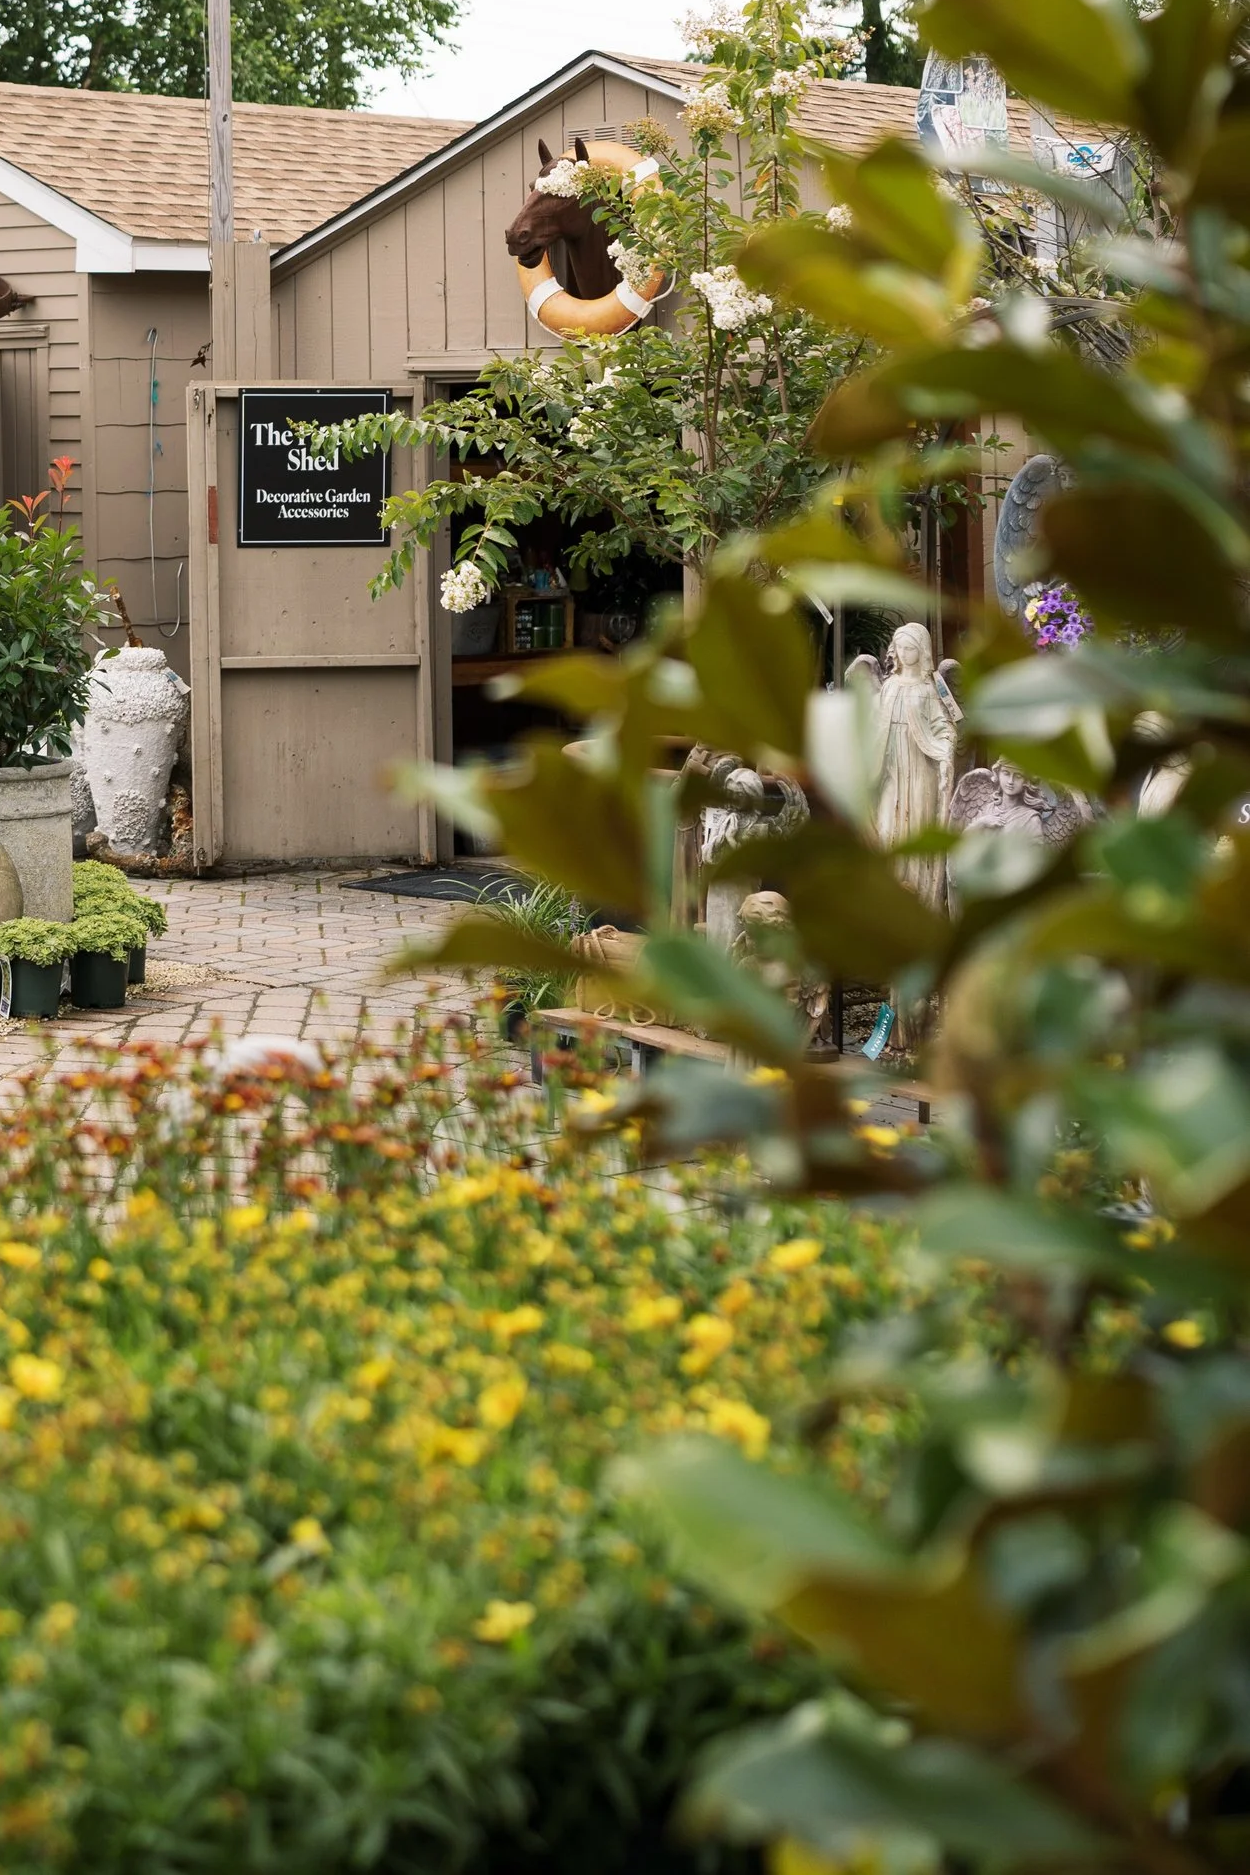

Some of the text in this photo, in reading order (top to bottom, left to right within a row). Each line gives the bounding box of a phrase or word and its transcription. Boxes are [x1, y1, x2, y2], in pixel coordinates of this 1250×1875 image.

[250, 422, 293, 446] The
[287, 448, 339, 471] Shed
[256, 488, 371, 504] Decorative Garden
[277, 504, 350, 519] Accessories
[870, 1013, 890, 1053] CAMPANIA
